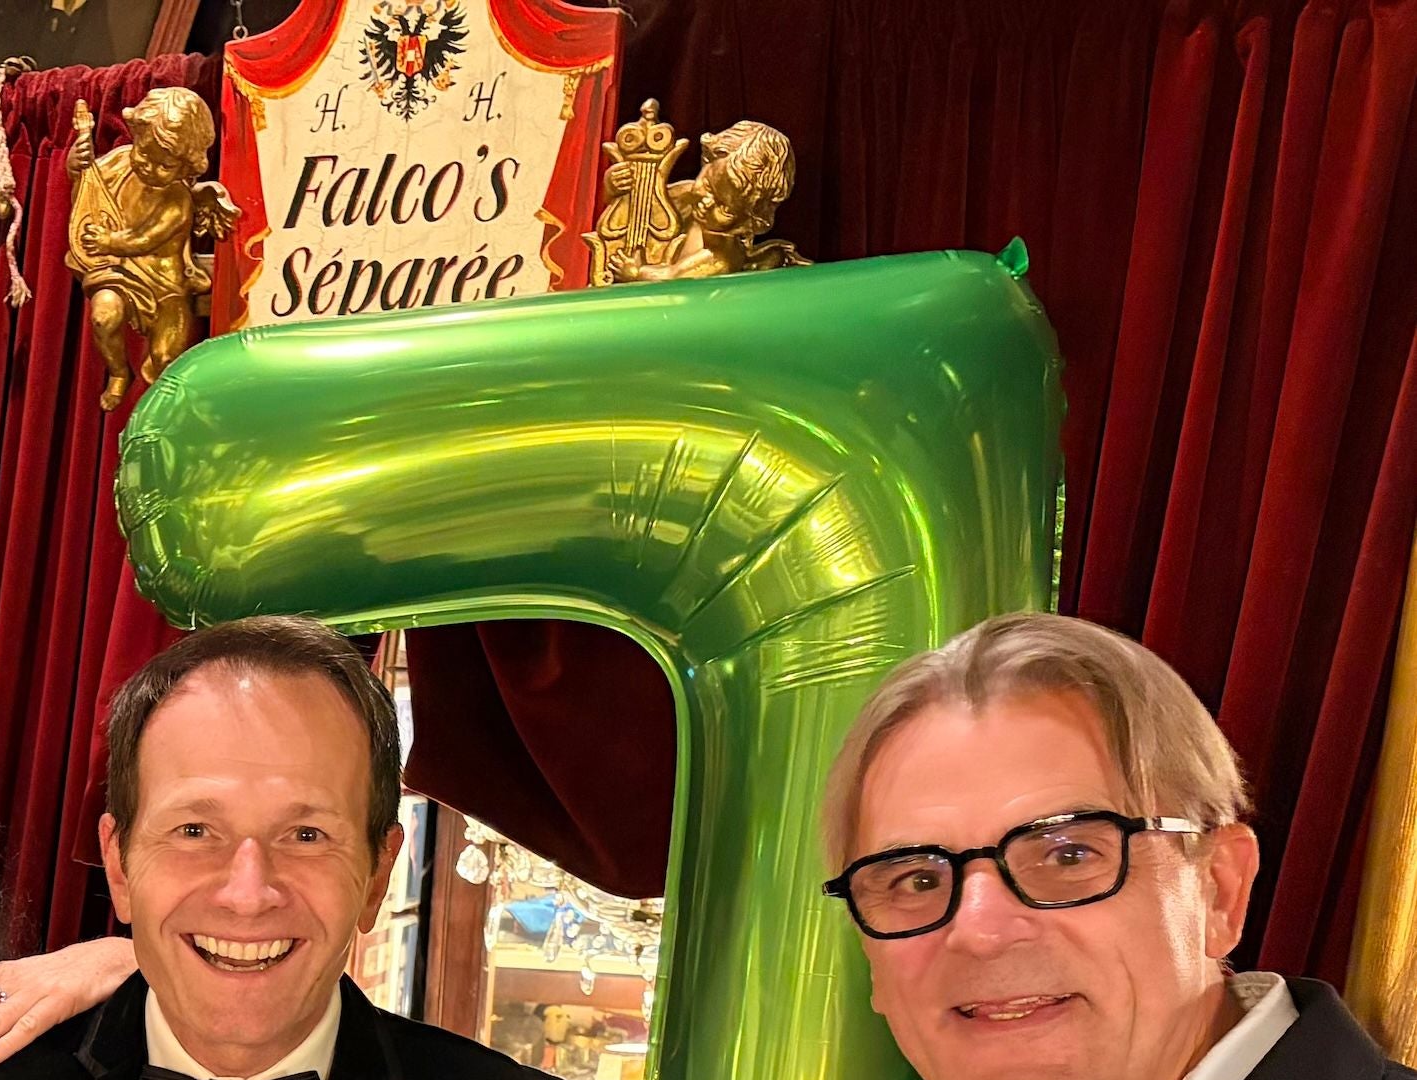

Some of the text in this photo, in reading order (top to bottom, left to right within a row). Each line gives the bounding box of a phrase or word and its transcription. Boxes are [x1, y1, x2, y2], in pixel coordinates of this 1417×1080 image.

[311, 71, 506, 133] H. H.
[282, 144, 520, 229] Falco's
[270, 244, 525, 318] Séparée
